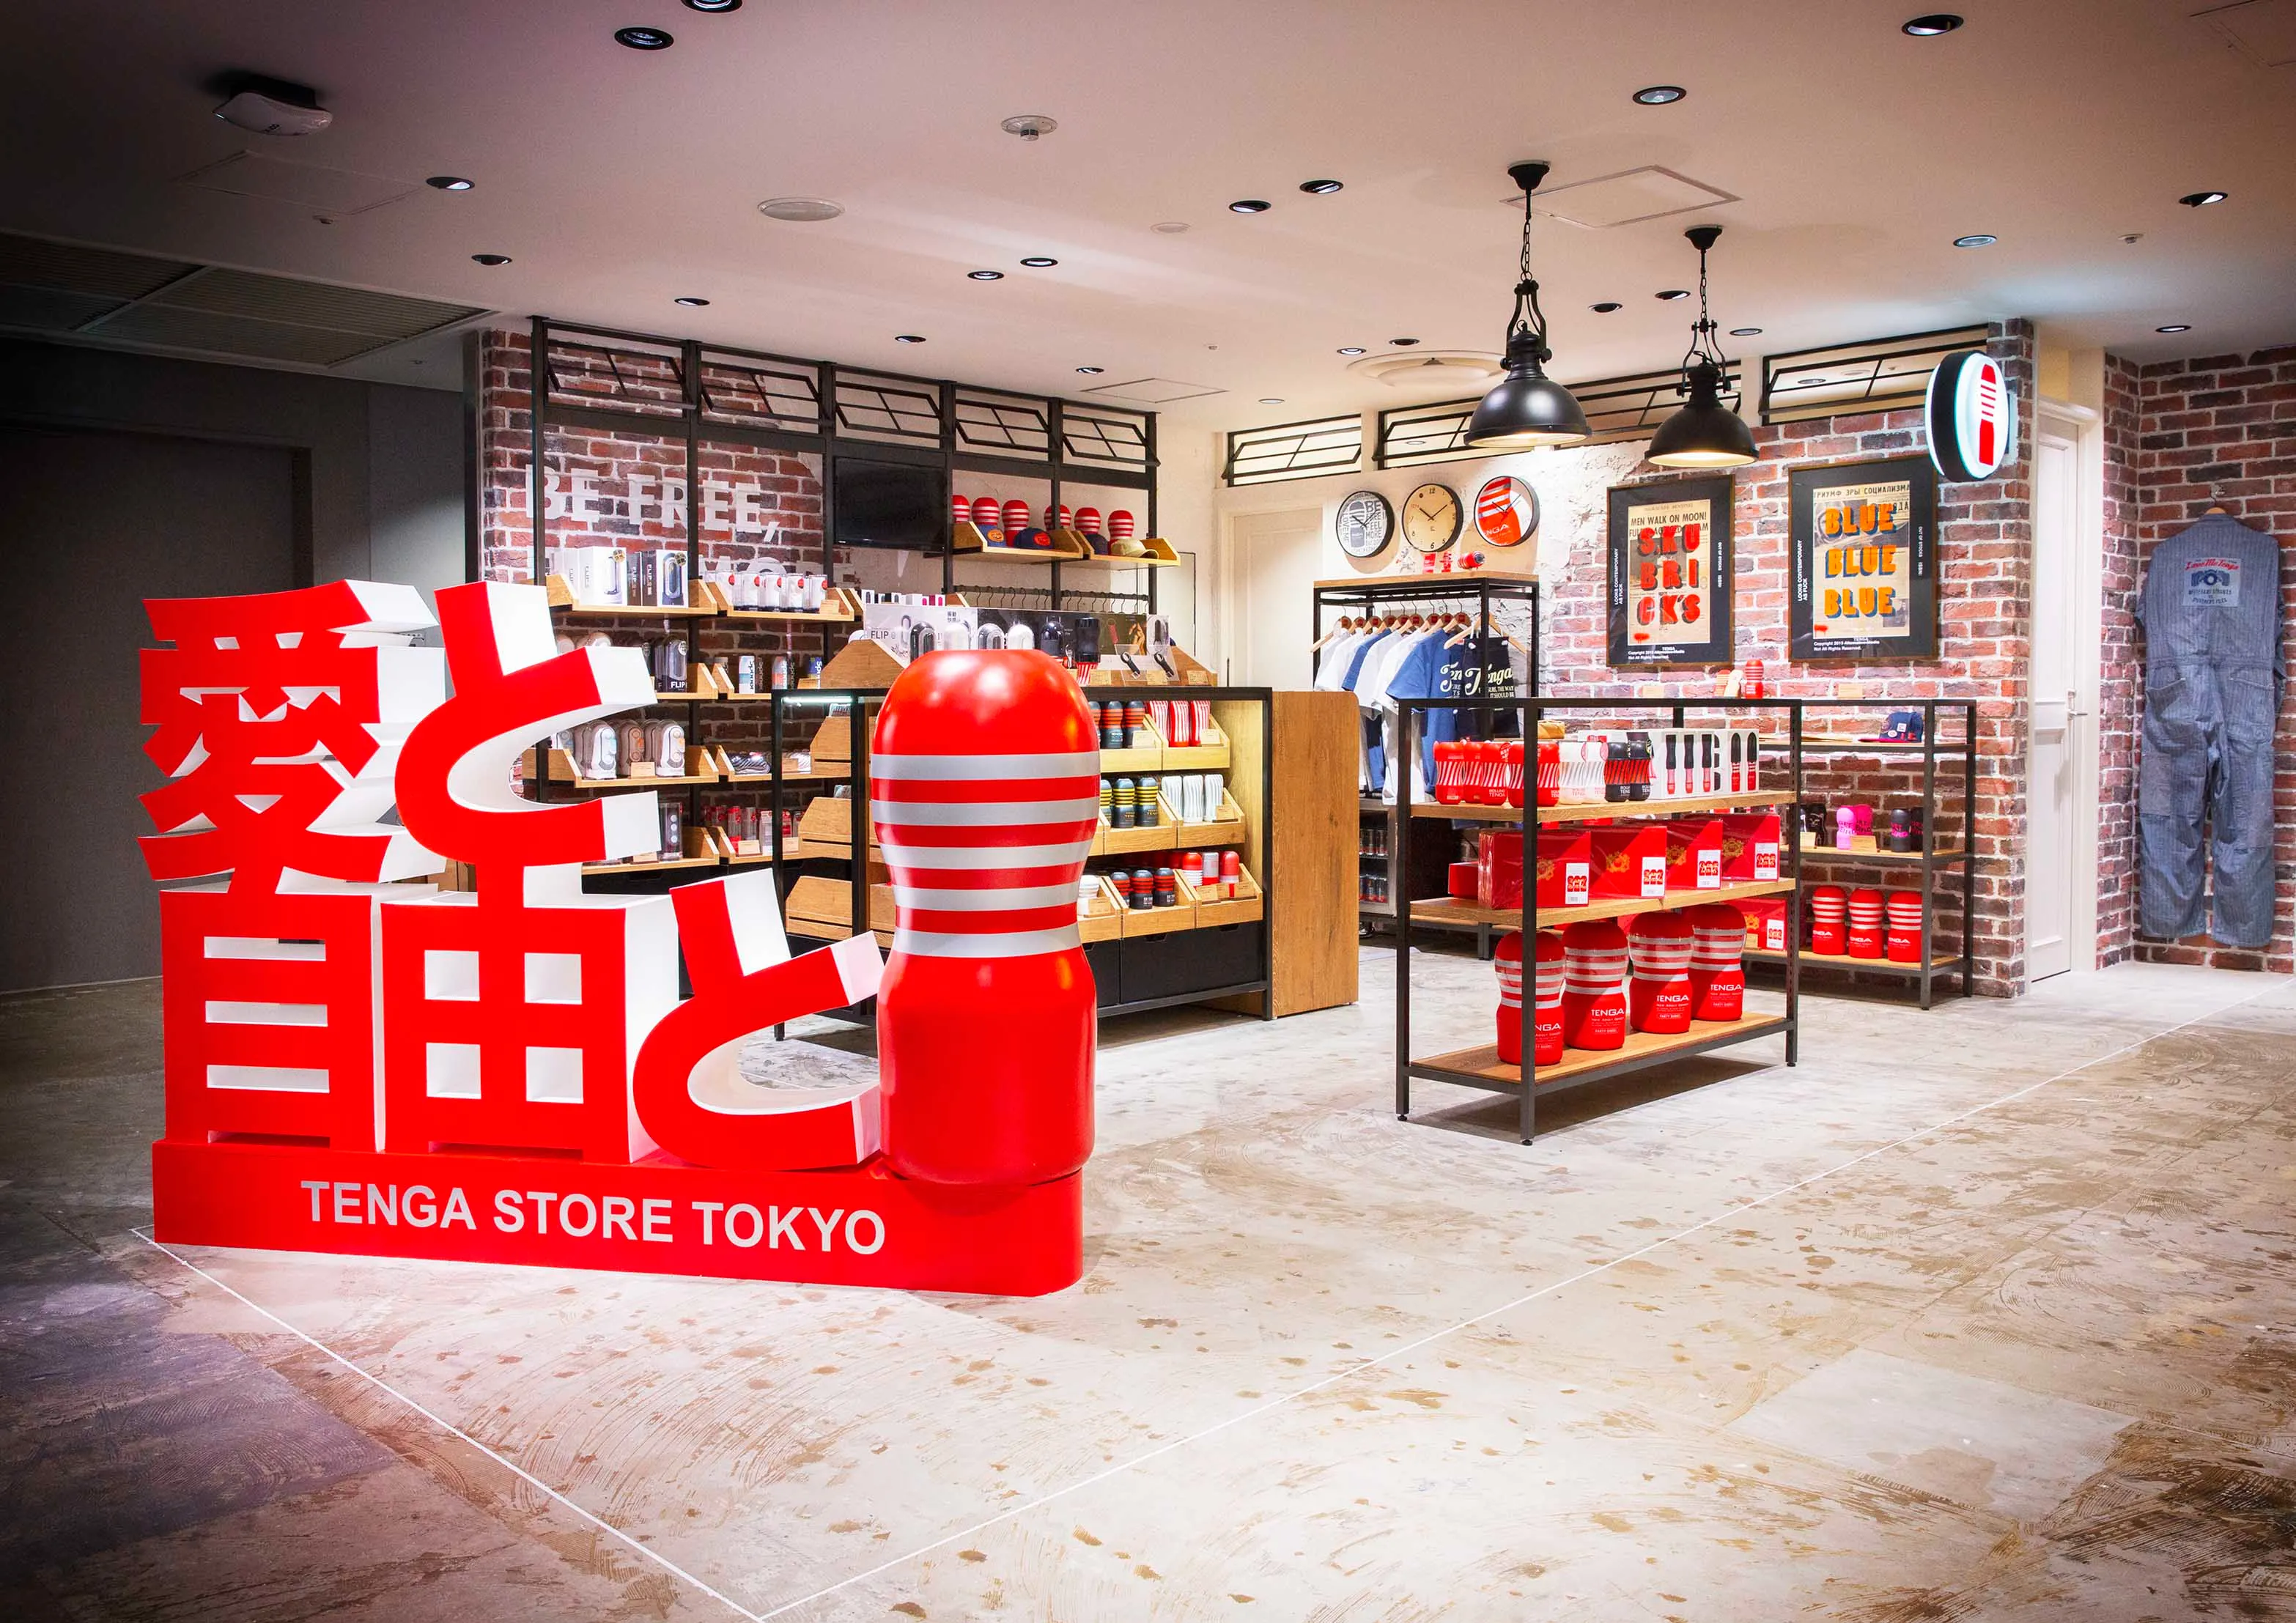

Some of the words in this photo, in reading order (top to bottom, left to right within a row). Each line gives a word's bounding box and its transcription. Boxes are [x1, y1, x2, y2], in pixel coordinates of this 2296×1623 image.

[525, 465, 599, 522] BE
[627, 473, 780, 542] FREE,
[1365, 500, 1381, 512] BE
[1631, 517, 1645, 526] MEN
[1648, 515, 1666, 525] WALK
[1669, 514, 1680, 522] ON
[1683, 512, 1707, 522] MOON!
[1826, 503, 1897, 538] BLUE
[1825, 544, 1897, 578] BLUE
[1824, 587, 1896, 618] BLUE
[871, 631, 889, 639] FLIP
[1440, 662, 1462, 692] Ten
[1465, 664, 1513, 695] Tnga
[137, 579, 661, 884] 愛と
[158, 862, 884, 1171] 自由と
[1535, 1023, 1561, 1032] NGA
[1591, 1008, 1625, 1017] TENGA
[301, 1180, 477, 1230] TENGA
[494, 1189, 673, 1243] STORE
[691, 1202, 885, 1255] TOKYO
